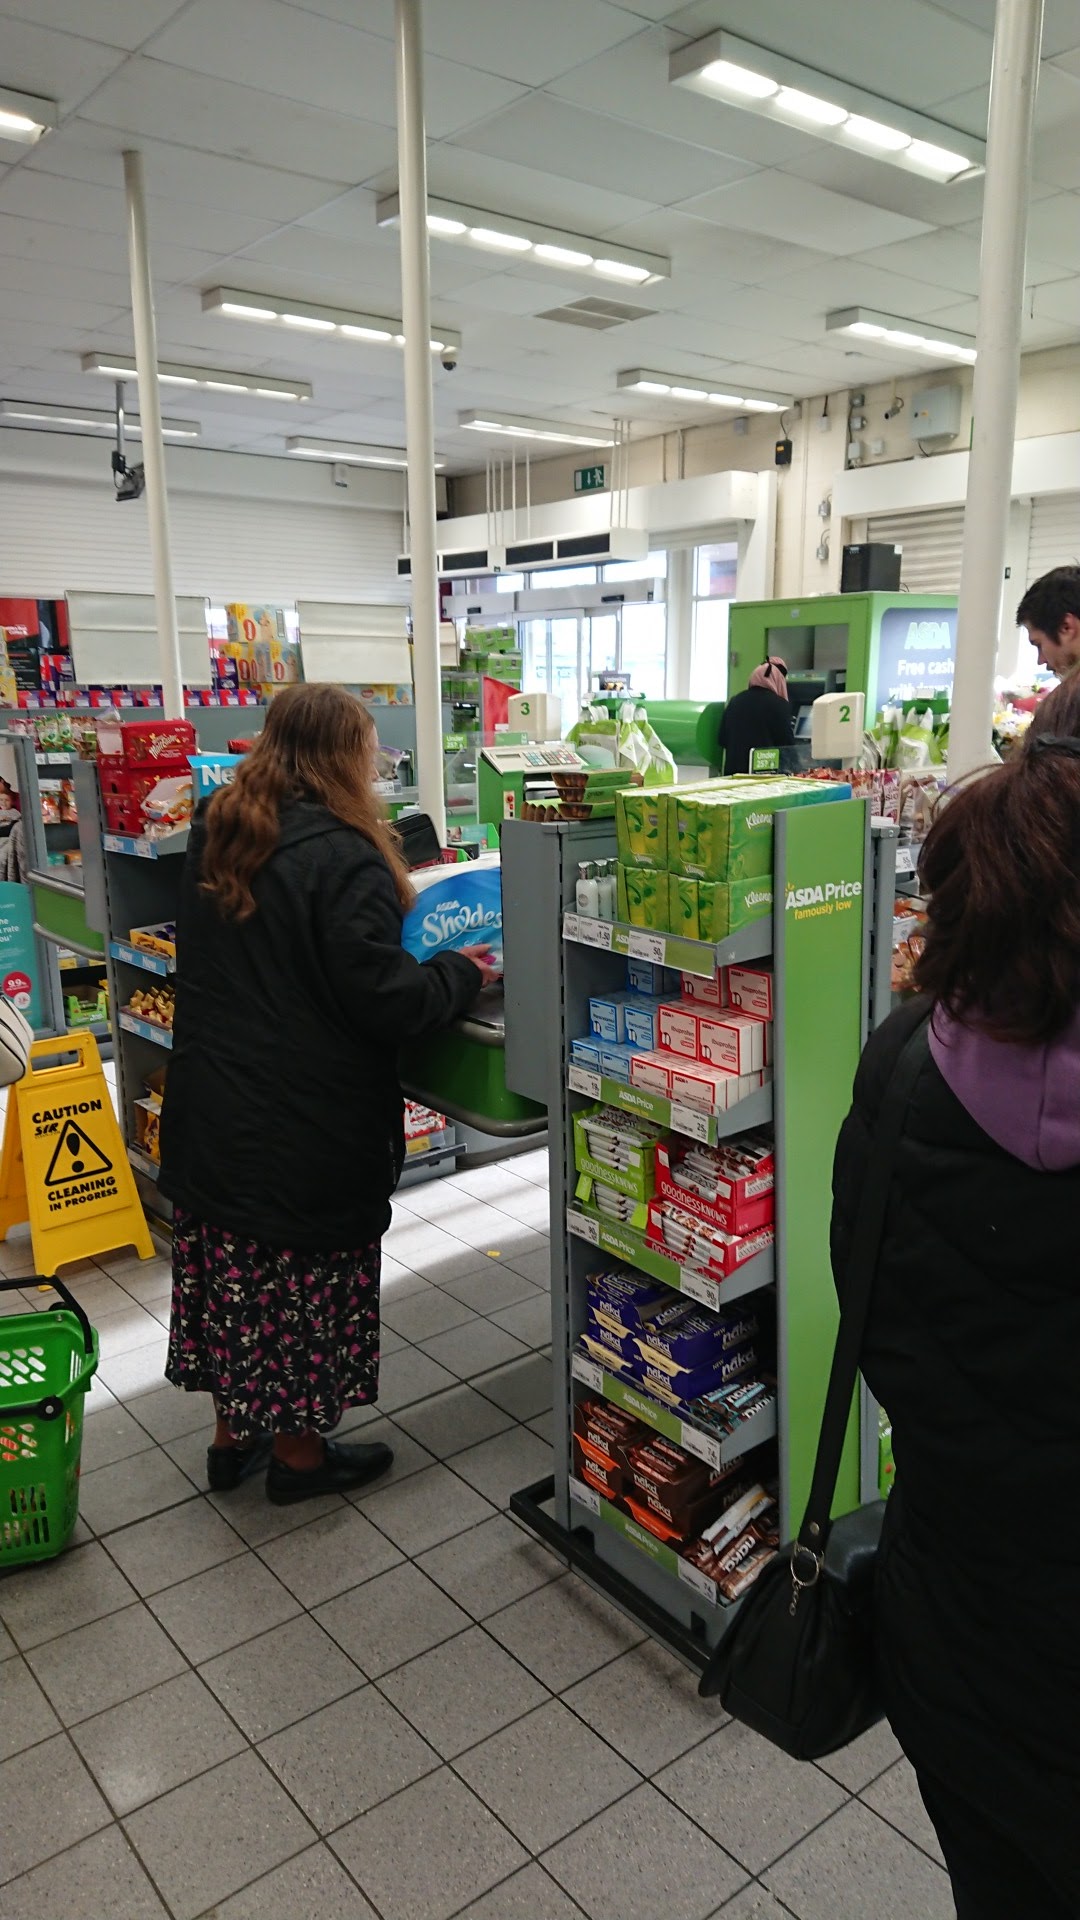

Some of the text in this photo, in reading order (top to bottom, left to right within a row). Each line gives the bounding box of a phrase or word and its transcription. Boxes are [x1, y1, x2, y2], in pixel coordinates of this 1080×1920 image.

[904, 621, 951, 650] ASDA
[898, 657, 955, 676] Free cash
[521, 703, 531, 716] 3
[839, 705, 851, 722] 2
[446, 735, 464, 743] Under
[756, 751, 777, 760] Under
[202, 764, 236, 786] Ne
[785, 880, 862, 910] ASDA Price
[794, 900, 852, 920] famously low
[619, 1090, 654, 1111] ASDA Price
[32, 1099, 103, 1124] CAUTION
[35, 1122, 59, 1136] SIR
[48, 1176, 116, 1202] CLEANING
[49, 1187, 118, 1212] IN PROGRESS
[619, 1239, 636, 1256] Price
